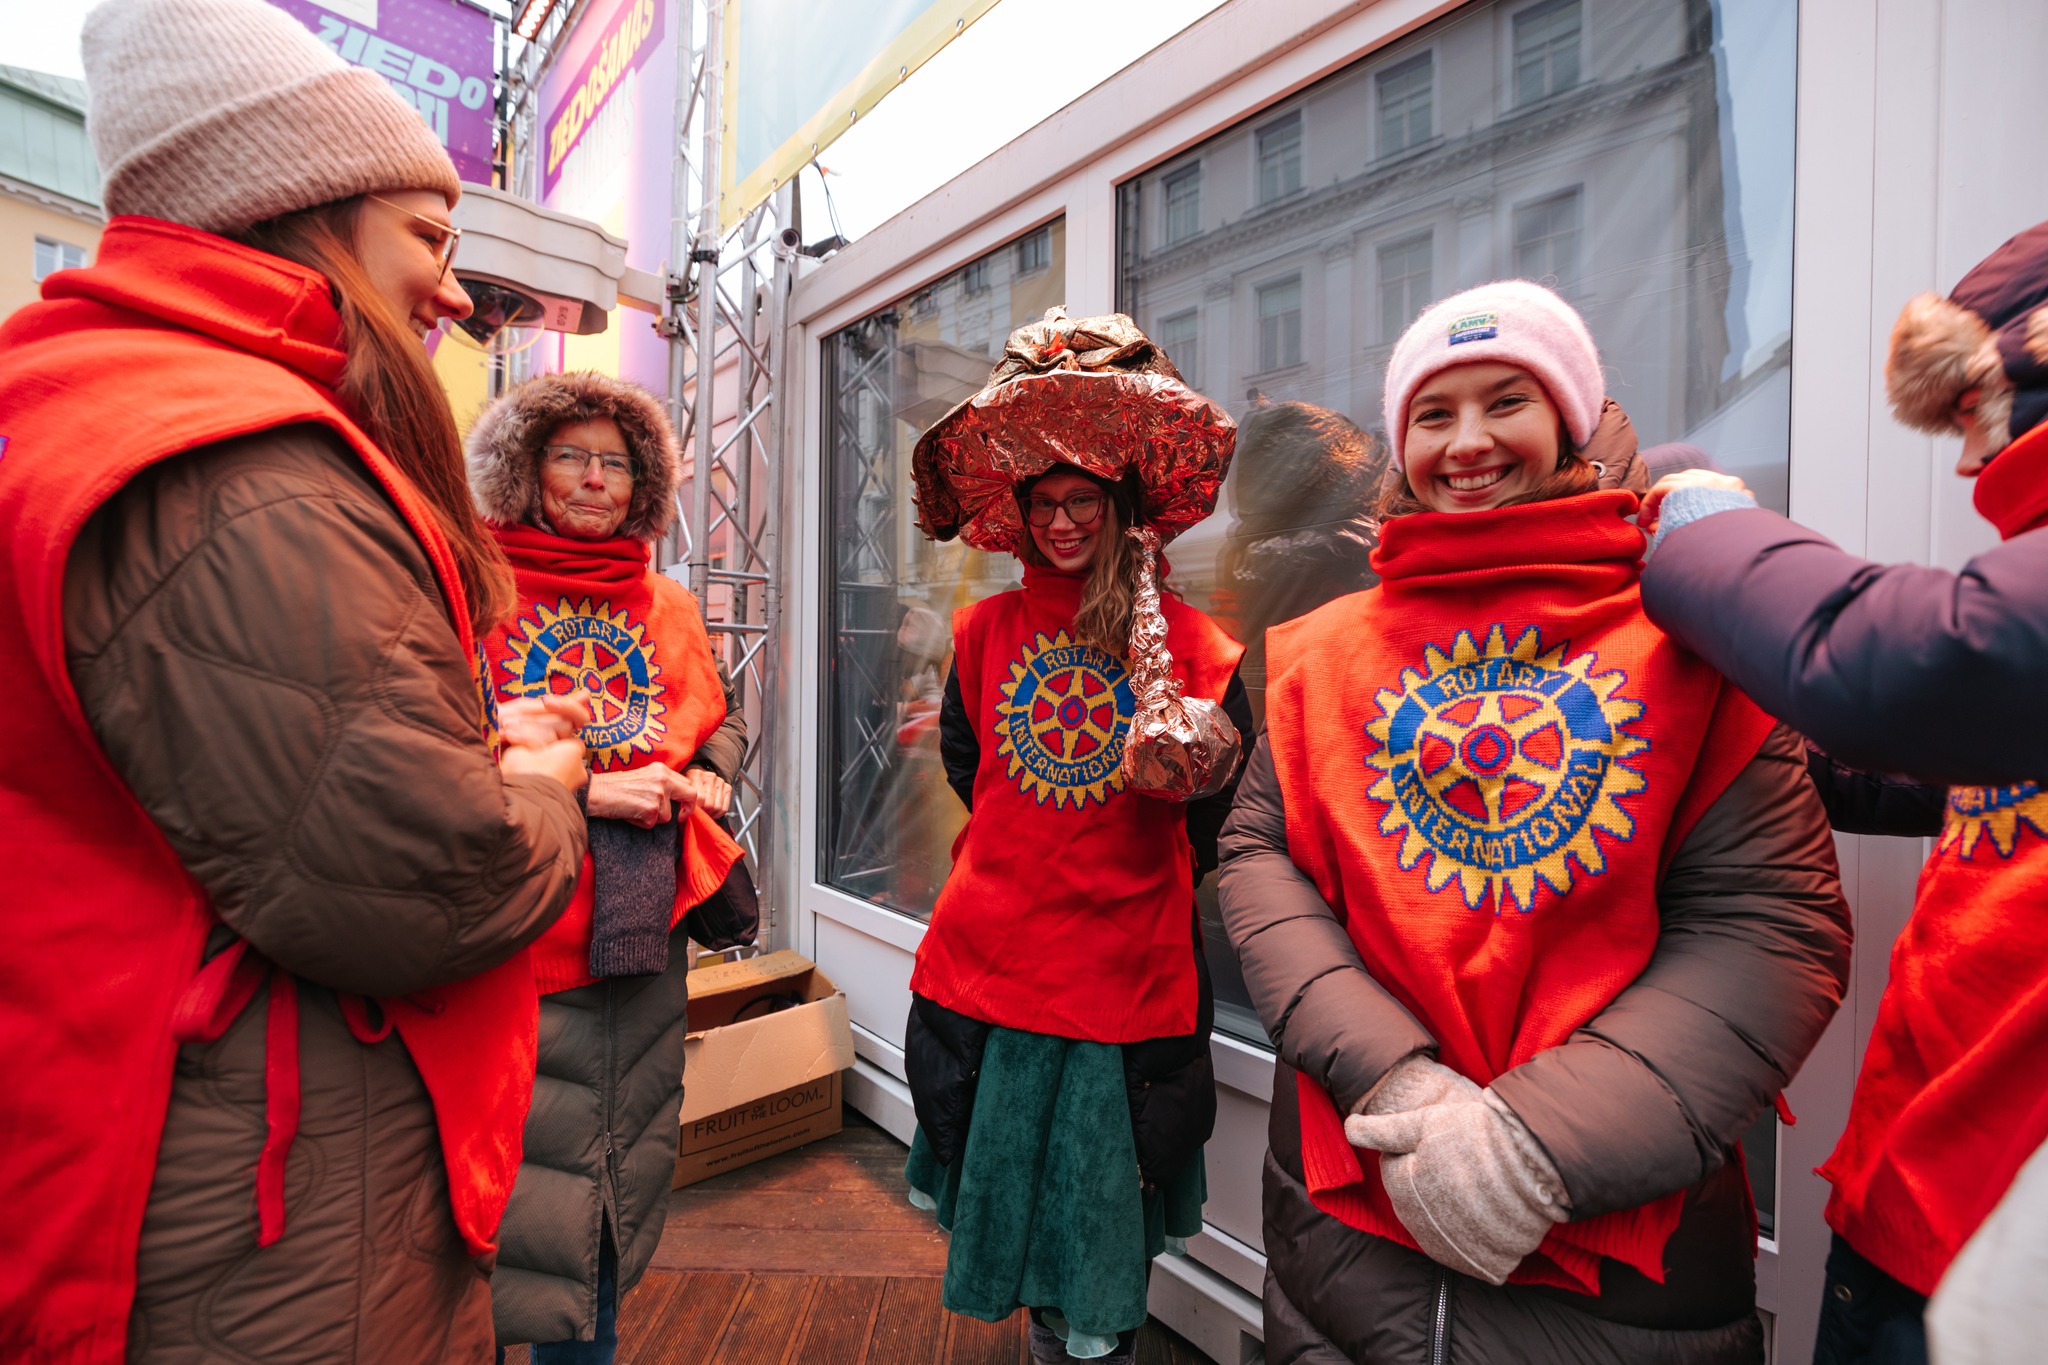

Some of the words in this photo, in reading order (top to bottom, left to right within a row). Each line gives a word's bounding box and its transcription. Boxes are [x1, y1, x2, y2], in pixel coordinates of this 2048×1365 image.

[550, 617, 629, 645] ROTARY
[1042, 647, 1121, 674] ROTARY
[1437, 659, 1562, 698] ROTARY
[1398, 757, 1603, 867] INTERNATIONAL
[750, 1110, 767, 1121] THE
[752, 1103, 766, 1113] OF
[693, 1109, 750, 1139] FRUIT
